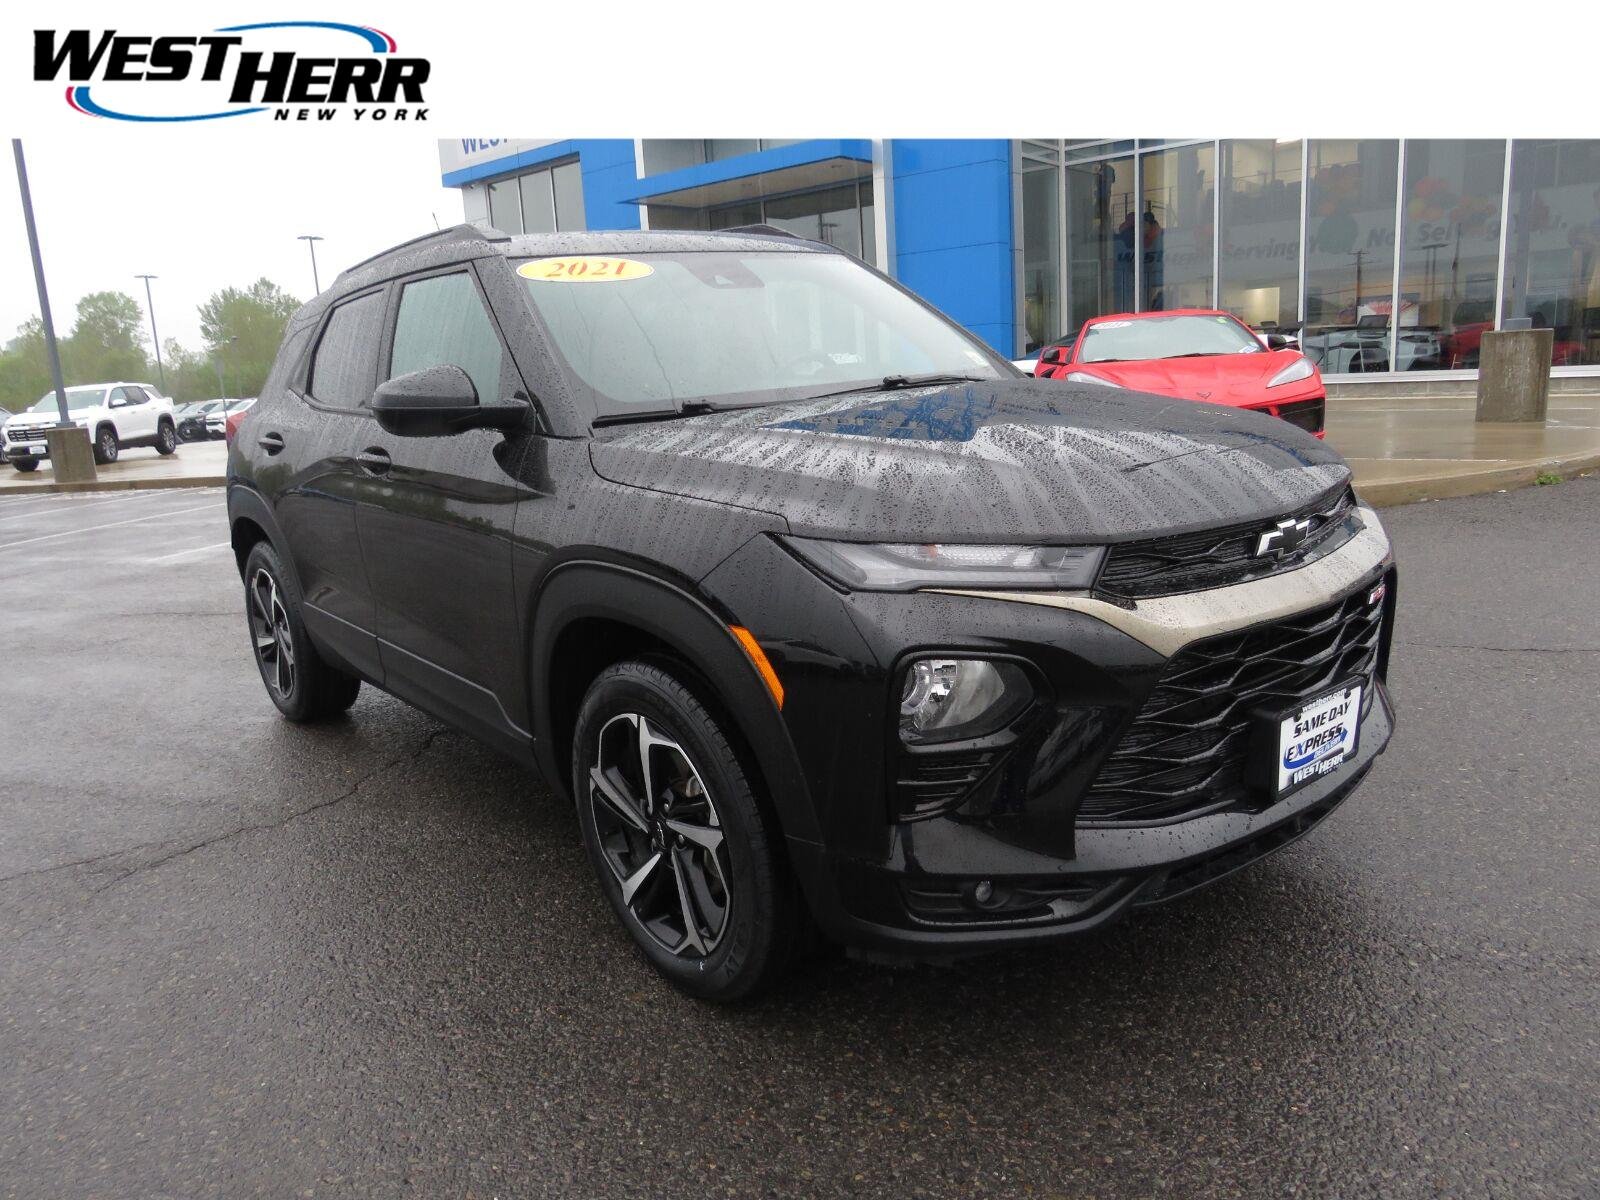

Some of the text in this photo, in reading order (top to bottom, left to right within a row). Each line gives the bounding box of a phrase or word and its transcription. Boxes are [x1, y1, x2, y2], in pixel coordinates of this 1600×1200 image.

[545, 262, 627, 277] 2021
[1293, 700, 1352, 738] SAME DAY
[1286, 722, 1344, 761] EXPRESS
